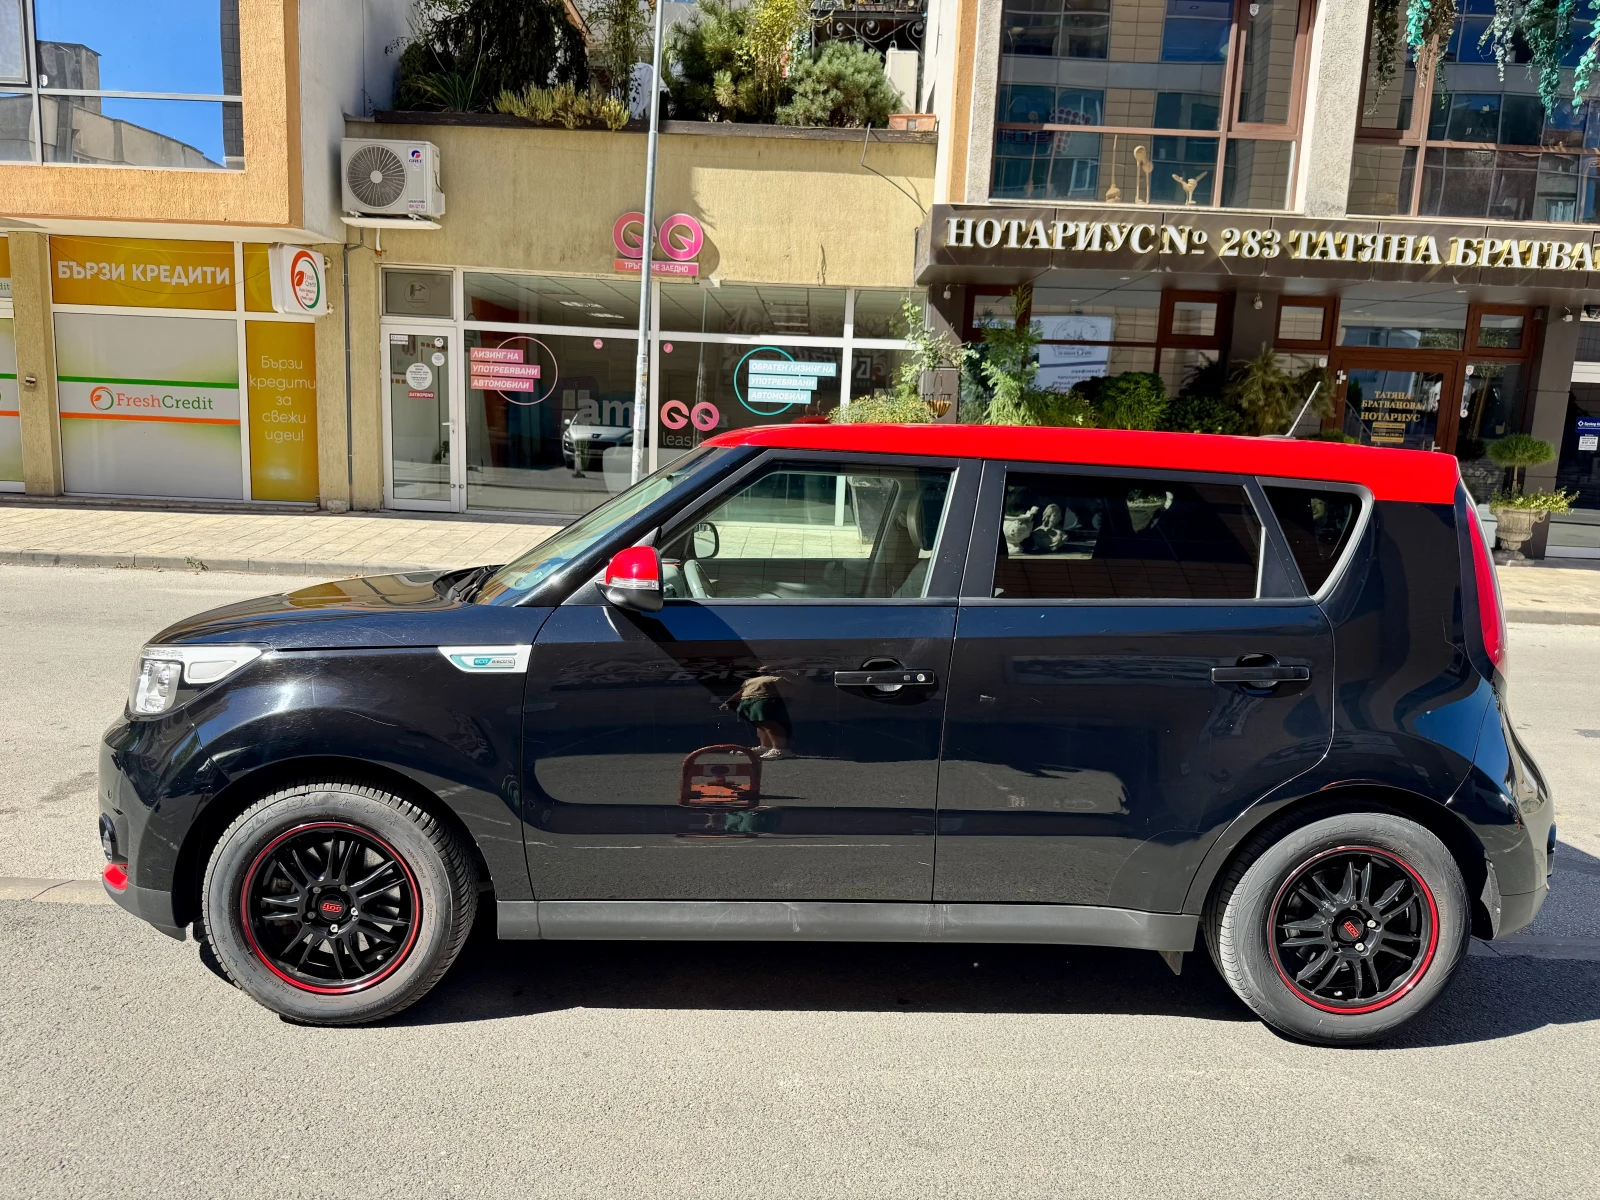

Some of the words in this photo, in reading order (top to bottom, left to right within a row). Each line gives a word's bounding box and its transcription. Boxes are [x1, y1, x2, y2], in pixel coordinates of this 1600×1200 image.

[944, 216, 1156, 255] НОТАРИУС
[1219, 227, 1282, 259] 283
[1289, 229, 1441, 265] ТАТЯНА
[1446, 236, 1600, 272] БРАТВА
[57, 260, 125, 281] БЪРЗИ
[132, 264, 230, 286] КРЕДИТИ
[624, 262, 660, 271] ТРЪГМЕ
[661, 264, 689, 273] ЗАЕДНО
[472, 350, 506, 359] ЛИЗИНГ
[507, 352, 519, 360] НА
[261, 355, 303, 371] Бързи
[751, 362, 788, 372] ОБРАТЕН
[788, 364, 822, 372] ЛИЗИНГ
[822, 365, 834, 373] НА
[472, 365, 538, 376] УПОТРЕБЯВАНИ
[249, 374, 316, 391] кредити
[472, 379, 530, 389] АВТОМОБИЛИ
[751, 377, 814, 387] УПОТРЕБЯВАНИ
[275, 395, 292, 406] за
[751, 391, 807, 400] АВТОМОБИЛИ
[1374, 390, 1412, 400] ТАТЯНА
[116, 393, 213, 410] FreshCredit
[1361, 399, 1422, 410] БРАТВАНОВА
[262, 409, 306, 424] свежи
[1360, 411, 1421, 422] НОТАРИУС
[265, 428, 304, 443] идеи!
